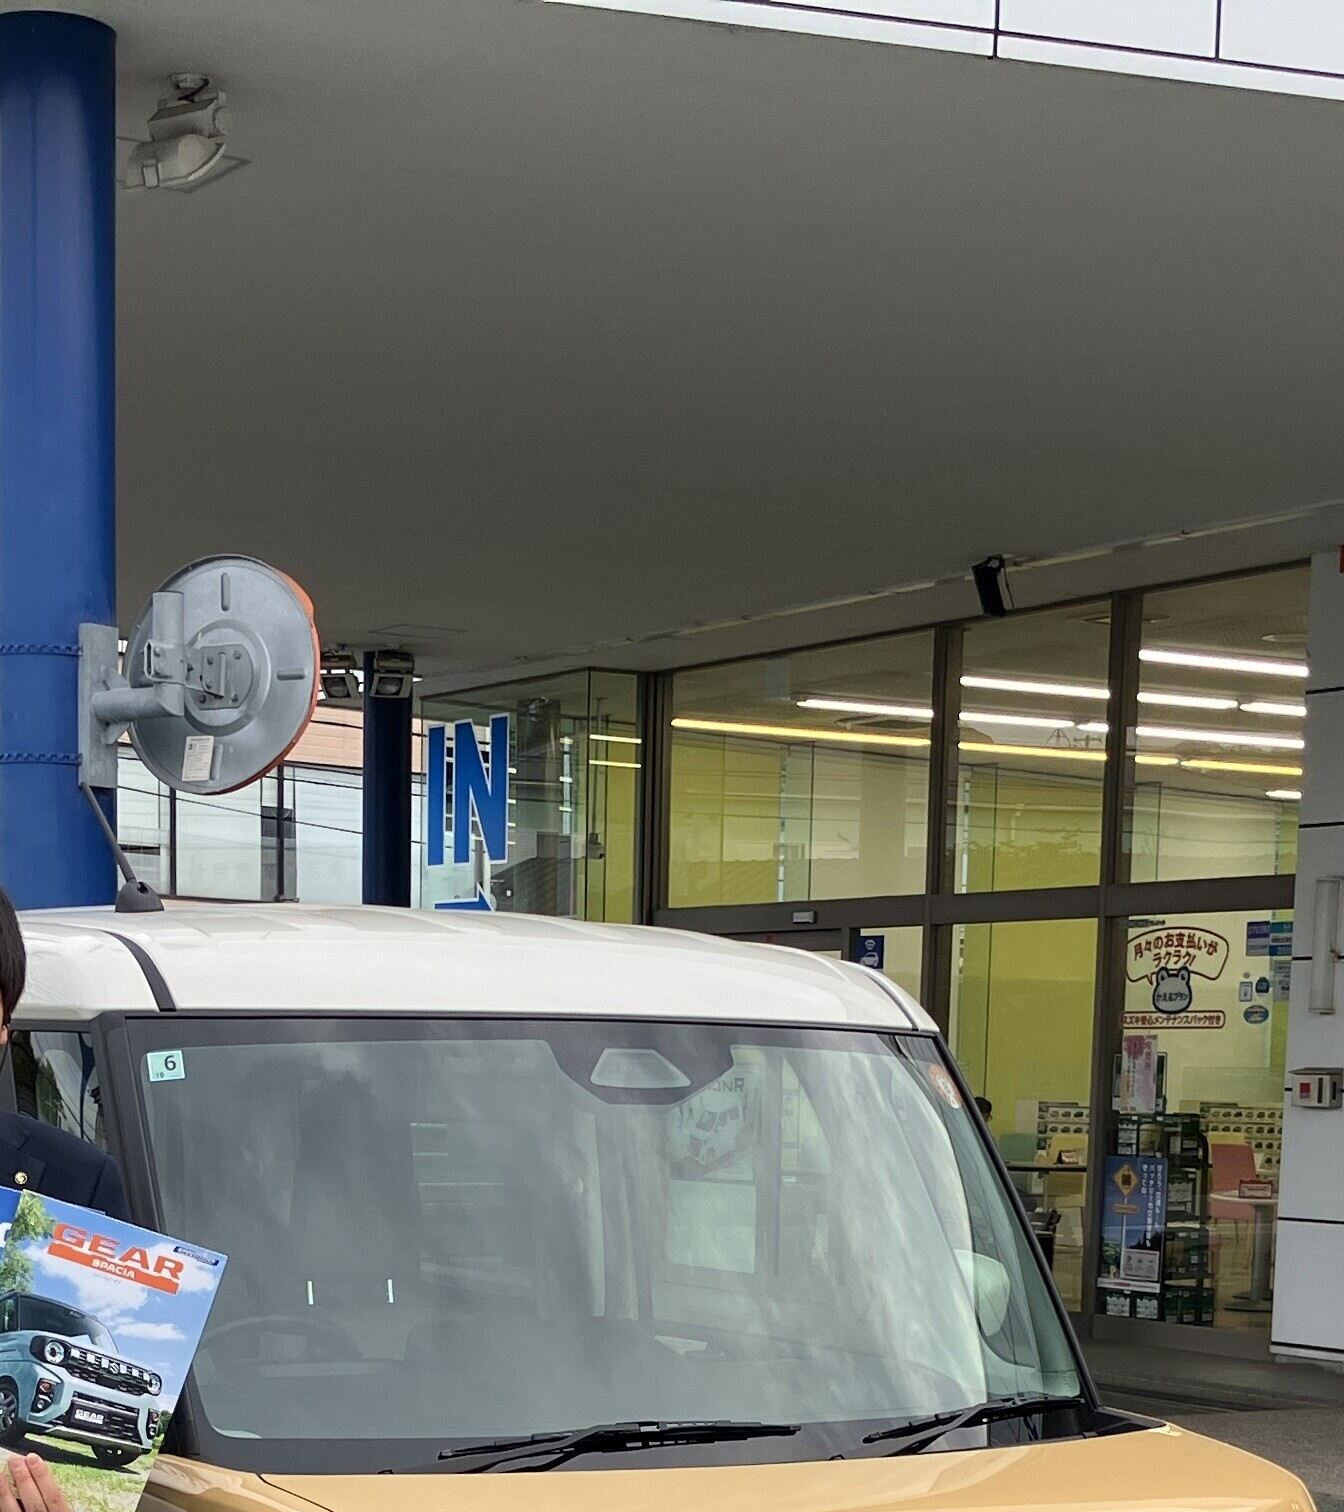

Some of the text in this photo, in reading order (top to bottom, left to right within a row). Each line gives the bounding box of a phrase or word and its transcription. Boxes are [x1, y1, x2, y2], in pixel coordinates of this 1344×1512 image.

[427, 712, 509, 866] IN
[1134, 932, 1218, 962] 月々のお支払いが
[164, 1054, 176, 1071] 6
[52, 1223, 184, 1280] GEAR
[91, 1258, 136, 1280] SPACIA
